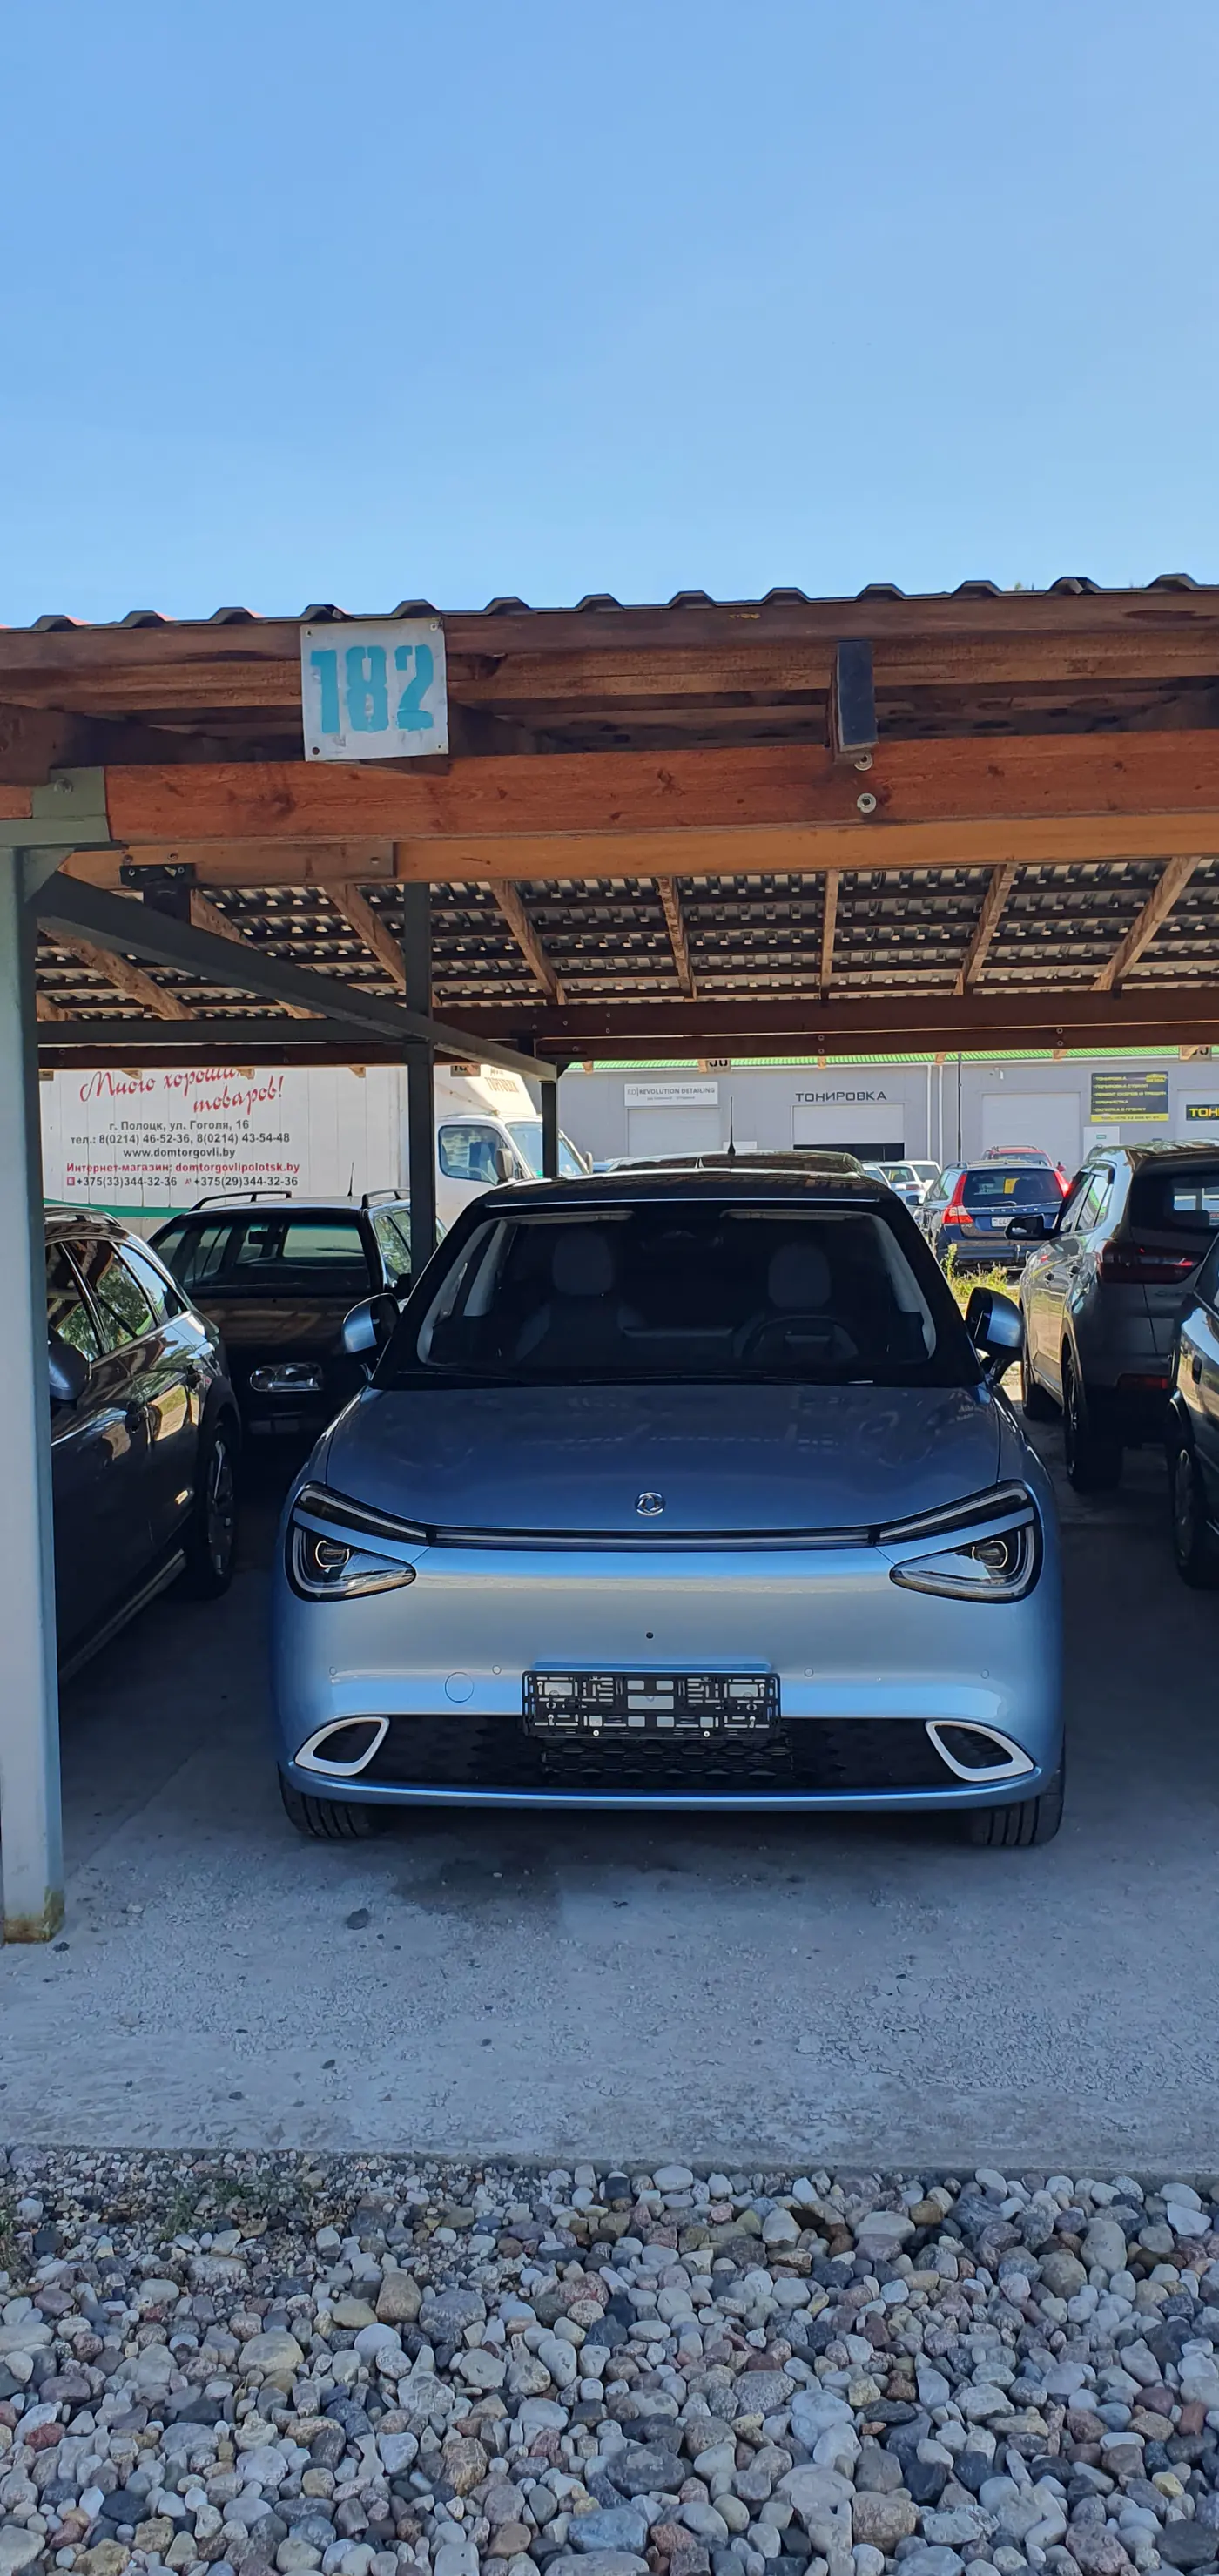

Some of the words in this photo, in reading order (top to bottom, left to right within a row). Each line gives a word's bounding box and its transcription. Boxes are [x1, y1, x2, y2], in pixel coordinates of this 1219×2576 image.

[310, 644, 434, 734] 182
[80, 1070, 156, 1102] Много
[164, 1068, 240, 1096] хороши
[193, 1075, 285, 1115] товаров!
[795, 1091, 887, 1102] ТОНИРОВКА
[1188, 1108, 1219, 1118] ТОН
[121, 1121, 166, 1131] Полоцк,
[170, 1122, 186, 1131] ул.
[190, 1120, 232, 1130] Гоголя,
[236, 1120, 249, 1129] 16
[98, 1135, 139, 1145] 8(0214)
[143, 1134, 193, 1144] 46-52-36,
[197, 1133, 239, 1144] 8(0214)
[242, 1133, 290, 1143] 43-54-48
[123, 1149, 236, 1158] www.domtorgovli.by
[66, 1163, 172, 1174] Интернет-магазин:
[175, 1162, 300, 1173] domtorgovlipolotsk.by
[77, 1177, 178, 1188] +375(33)344-32-36
[194, 1177, 298, 1188] +375(29)344-32-36
